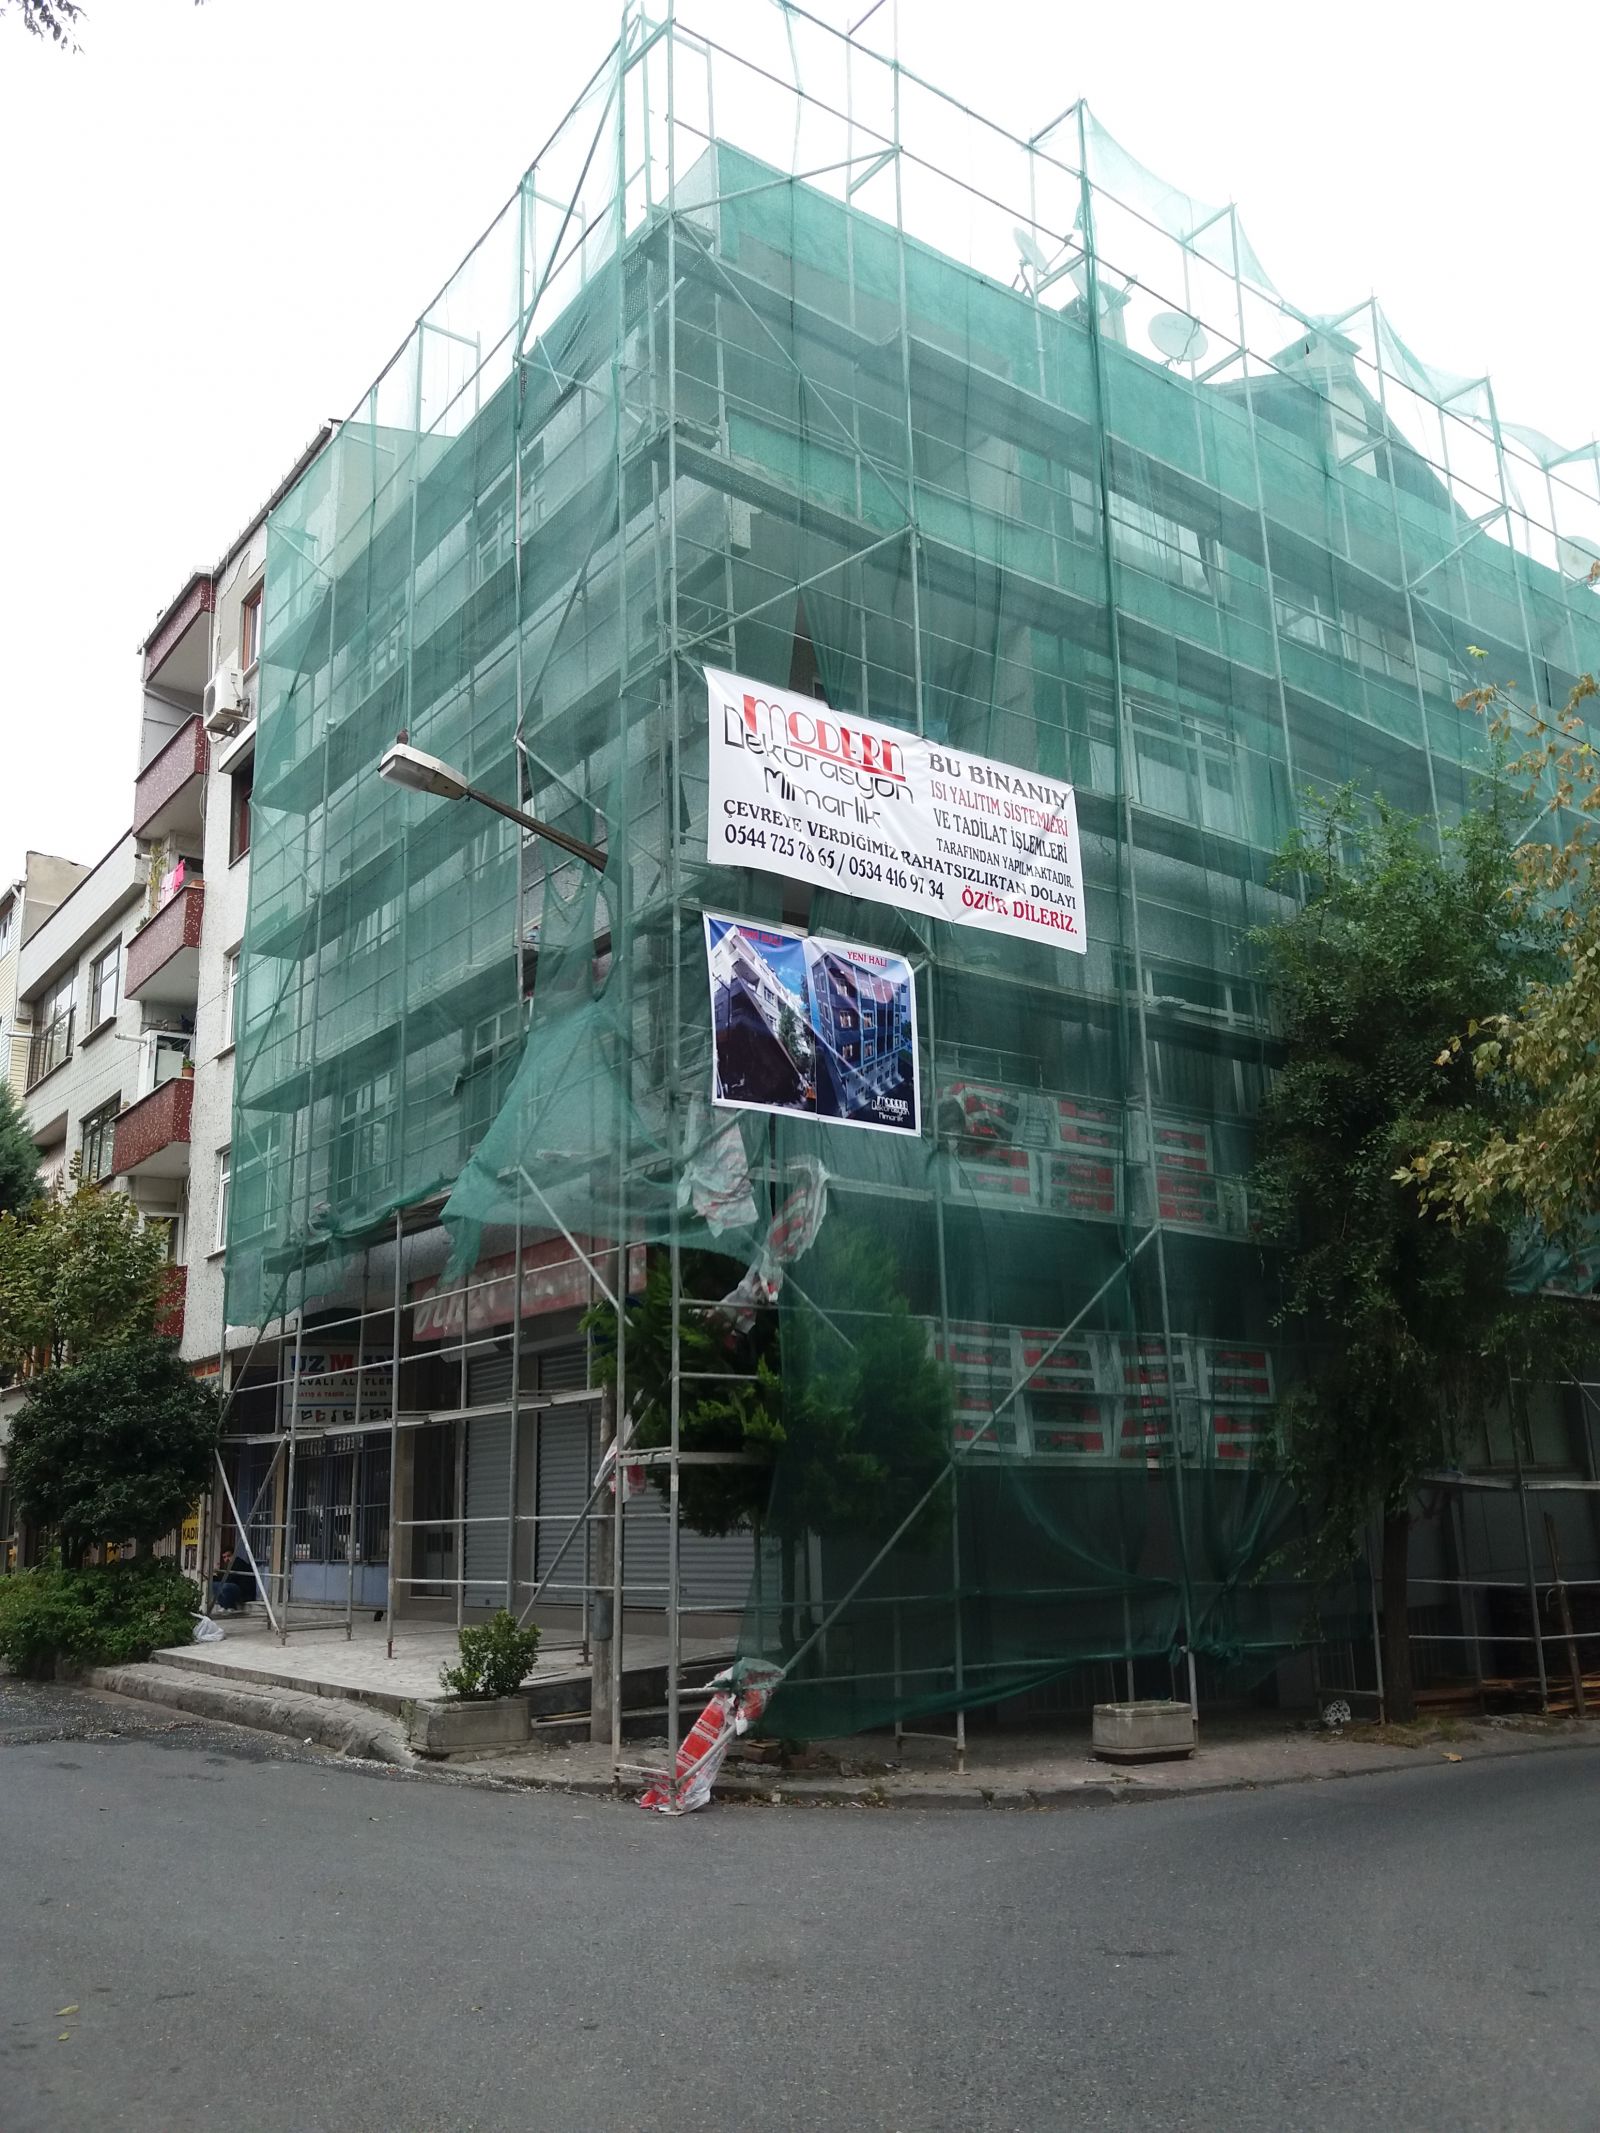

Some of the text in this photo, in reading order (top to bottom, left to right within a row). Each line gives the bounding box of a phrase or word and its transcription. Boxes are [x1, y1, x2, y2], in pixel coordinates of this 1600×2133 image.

[724, 704, 914, 804] Dekorasyon
[743, 694, 905, 775] MODERN
[764, 766, 881, 829] Mimarlık
[928, 753, 1067, 810] BU BİNANIN
[931, 780, 1068, 837] ISI YALITIM SİSTEMLERİ
[723, 799, 1076, 919] ÇEVREYE VERDİĞİMİZ RAHATSIZLIKTAN DOLAYI
[725, 823, 767, 849] 0544
[770, 832, 795, 857] 725
[798, 841, 815, 863] 78
[818, 847, 835, 869] 65
[849, 856, 882, 882] 0534
[885, 867, 907, 889] 416
[910, 874, 925, 894] 97
[928, 879, 945, 900] 34
[933, 808, 1068, 864] VE TADİLAT İŞLEMLERİ
[936, 838, 1000, 867] TARAFINDAN
[961, 884, 1009, 916] ÖZÜR
[847, 951, 867, 963] YENİ
[291, 1377, 334, 1387] AVALI
